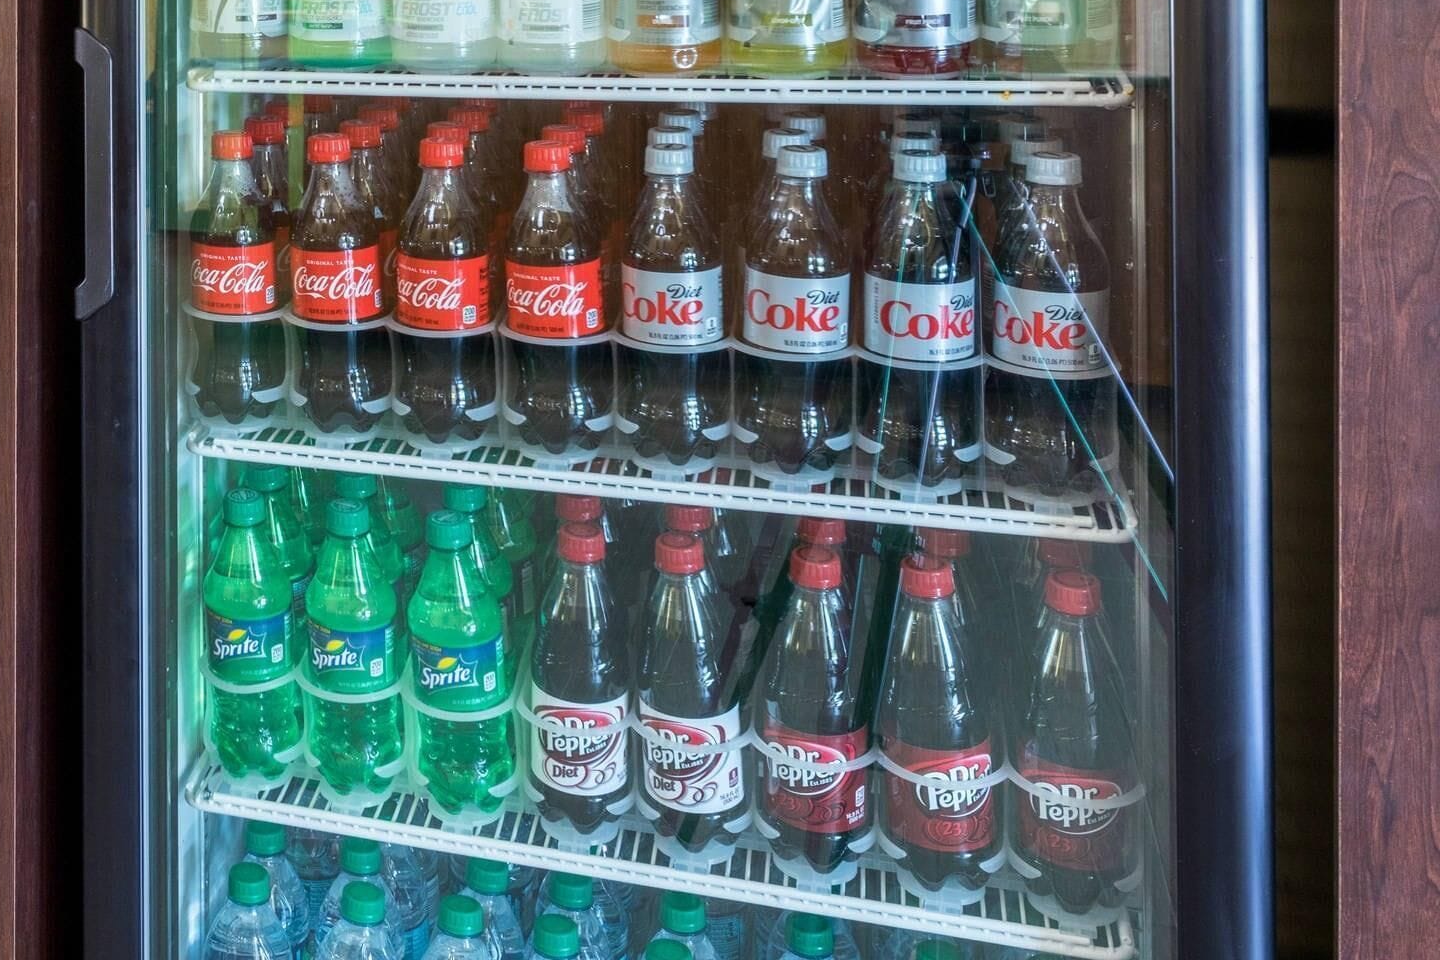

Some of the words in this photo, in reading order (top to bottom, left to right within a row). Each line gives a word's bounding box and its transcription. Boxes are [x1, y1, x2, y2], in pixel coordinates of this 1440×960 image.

[191, 257, 270, 295] Coca-Cola
[293, 264, 376, 300] Coca-Cola
[419, 268, 438, 276] TASTE
[507, 277, 588, 317] Coca-Cola
[666, 283, 704, 299] Diet
[807, 288, 842, 306] Diet
[463, 306, 476, 317] 200
[623, 282, 705, 327] Coke
[747, 288, 841, 333] Coke
[880, 300, 975, 340] Coke
[993, 300, 1087, 351] Coke
[213, 635, 260, 660] Sprite
[312, 645, 359, 670] Sprite
[420, 663, 471, 690] Sprite
[564, 716, 595, 731] Dr
[659, 729, 691, 745] Dr
[787, 744, 821, 764] Dr
[552, 765, 580, 779] Diet
[949, 762, 980, 783] Dr
[653, 777, 676, 792] Diet
[1061, 783, 1099, 802] Dr
